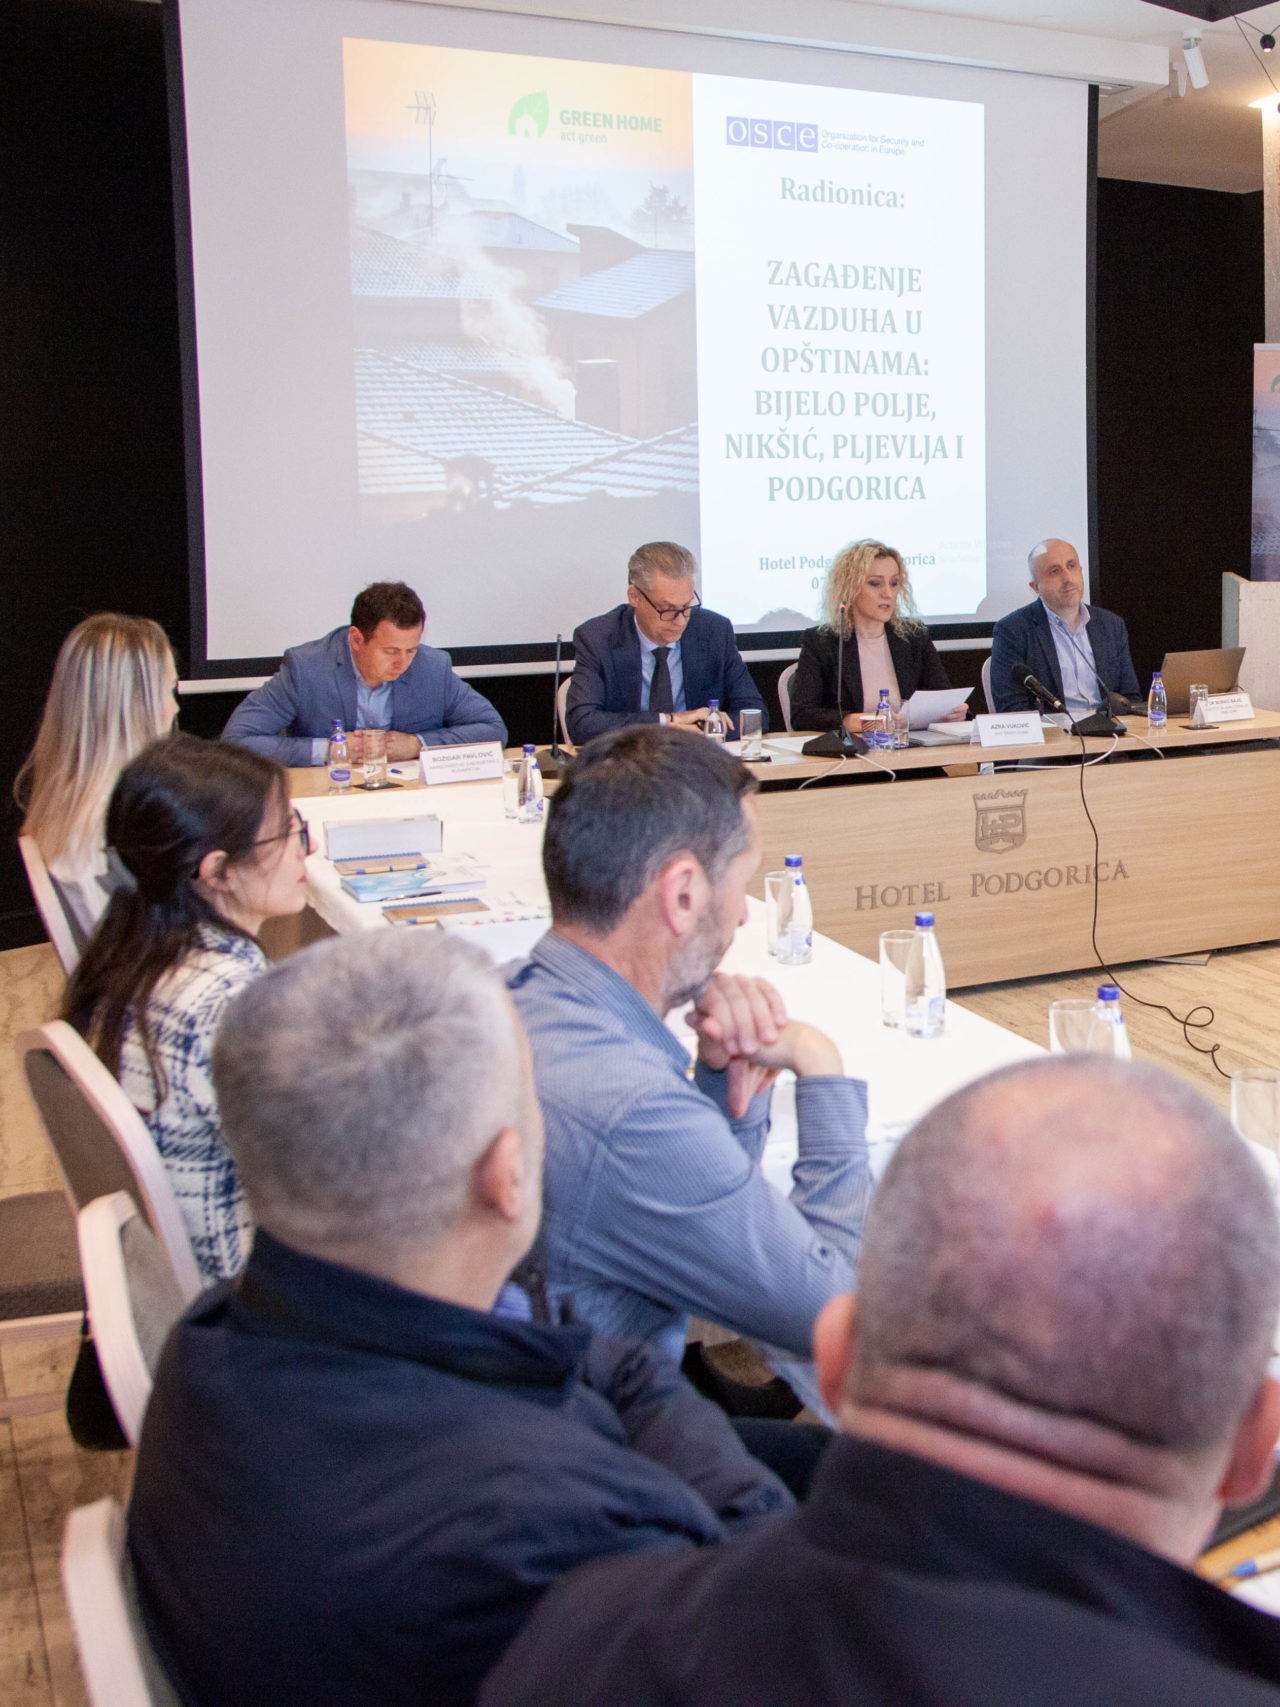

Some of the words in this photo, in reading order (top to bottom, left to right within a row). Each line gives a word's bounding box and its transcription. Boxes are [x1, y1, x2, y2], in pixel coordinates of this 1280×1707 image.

[560, 110, 613, 128] GREEN
[616, 114, 663, 133] HOME
[560, 131, 573, 142] act
[578, 133, 608, 145] green
[821, 129, 867, 143] Organization
[869, 134, 879, 143] for
[880, 135, 910, 147] Security
[911, 138, 925, 147] and
[821, 141, 871, 154] Co-operation
[880, 147, 905, 157] Europe
[781, 177, 905, 209] Radionica:
[767, 260, 922, 298] ZAGAĐENJE
[767, 304, 898, 334] VAZDUHA
[905, 310, 922, 335] U
[761, 341, 929, 377] OPŠTINAMA:
[754, 390, 846, 421] BIJELO
[854, 392, 937, 423] POLJE,
[724, 426, 824, 463] NIKŠIĆ,
[832, 433, 949, 465] PLJEVLJA
[956, 435, 964, 459] I
[767, 476, 927, 502] PODGORICA
[759, 555, 796, 571] Hotel
[855, 881, 950, 912] HOTEL
[970, 860, 1129, 898] PODGORICA
